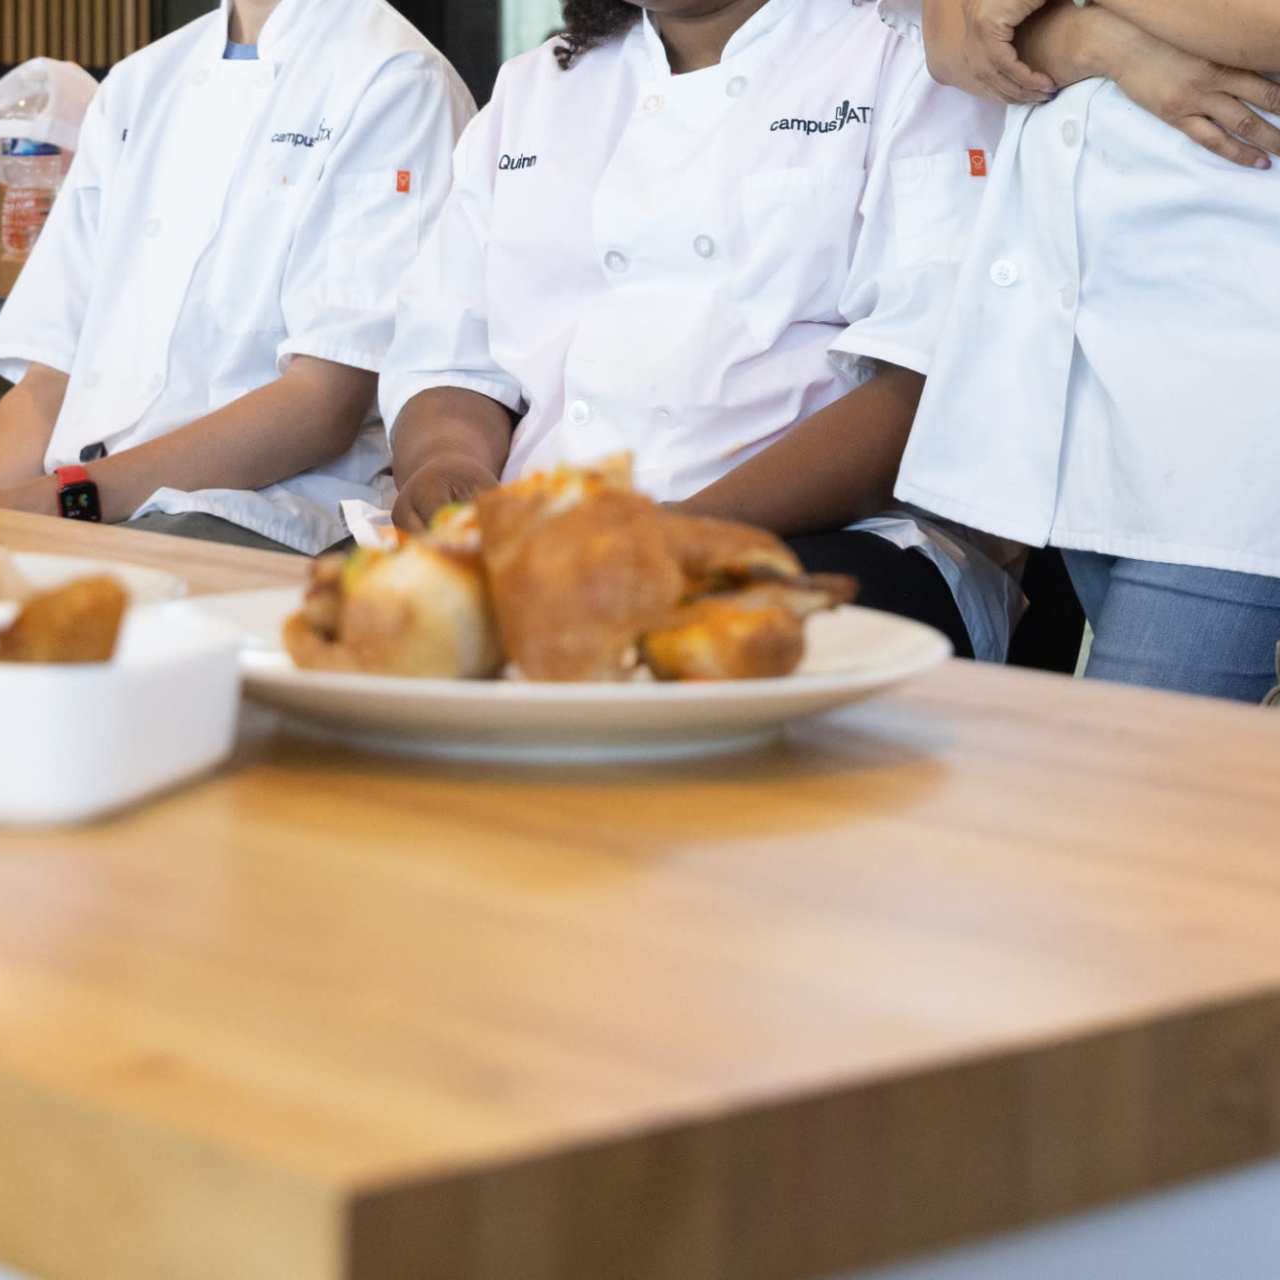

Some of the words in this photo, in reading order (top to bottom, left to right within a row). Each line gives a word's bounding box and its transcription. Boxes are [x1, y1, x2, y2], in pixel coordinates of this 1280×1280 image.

[770, 118, 838, 136] campus
[846, 106, 873, 124] AT
[499, 152, 537, 170] Quinn
